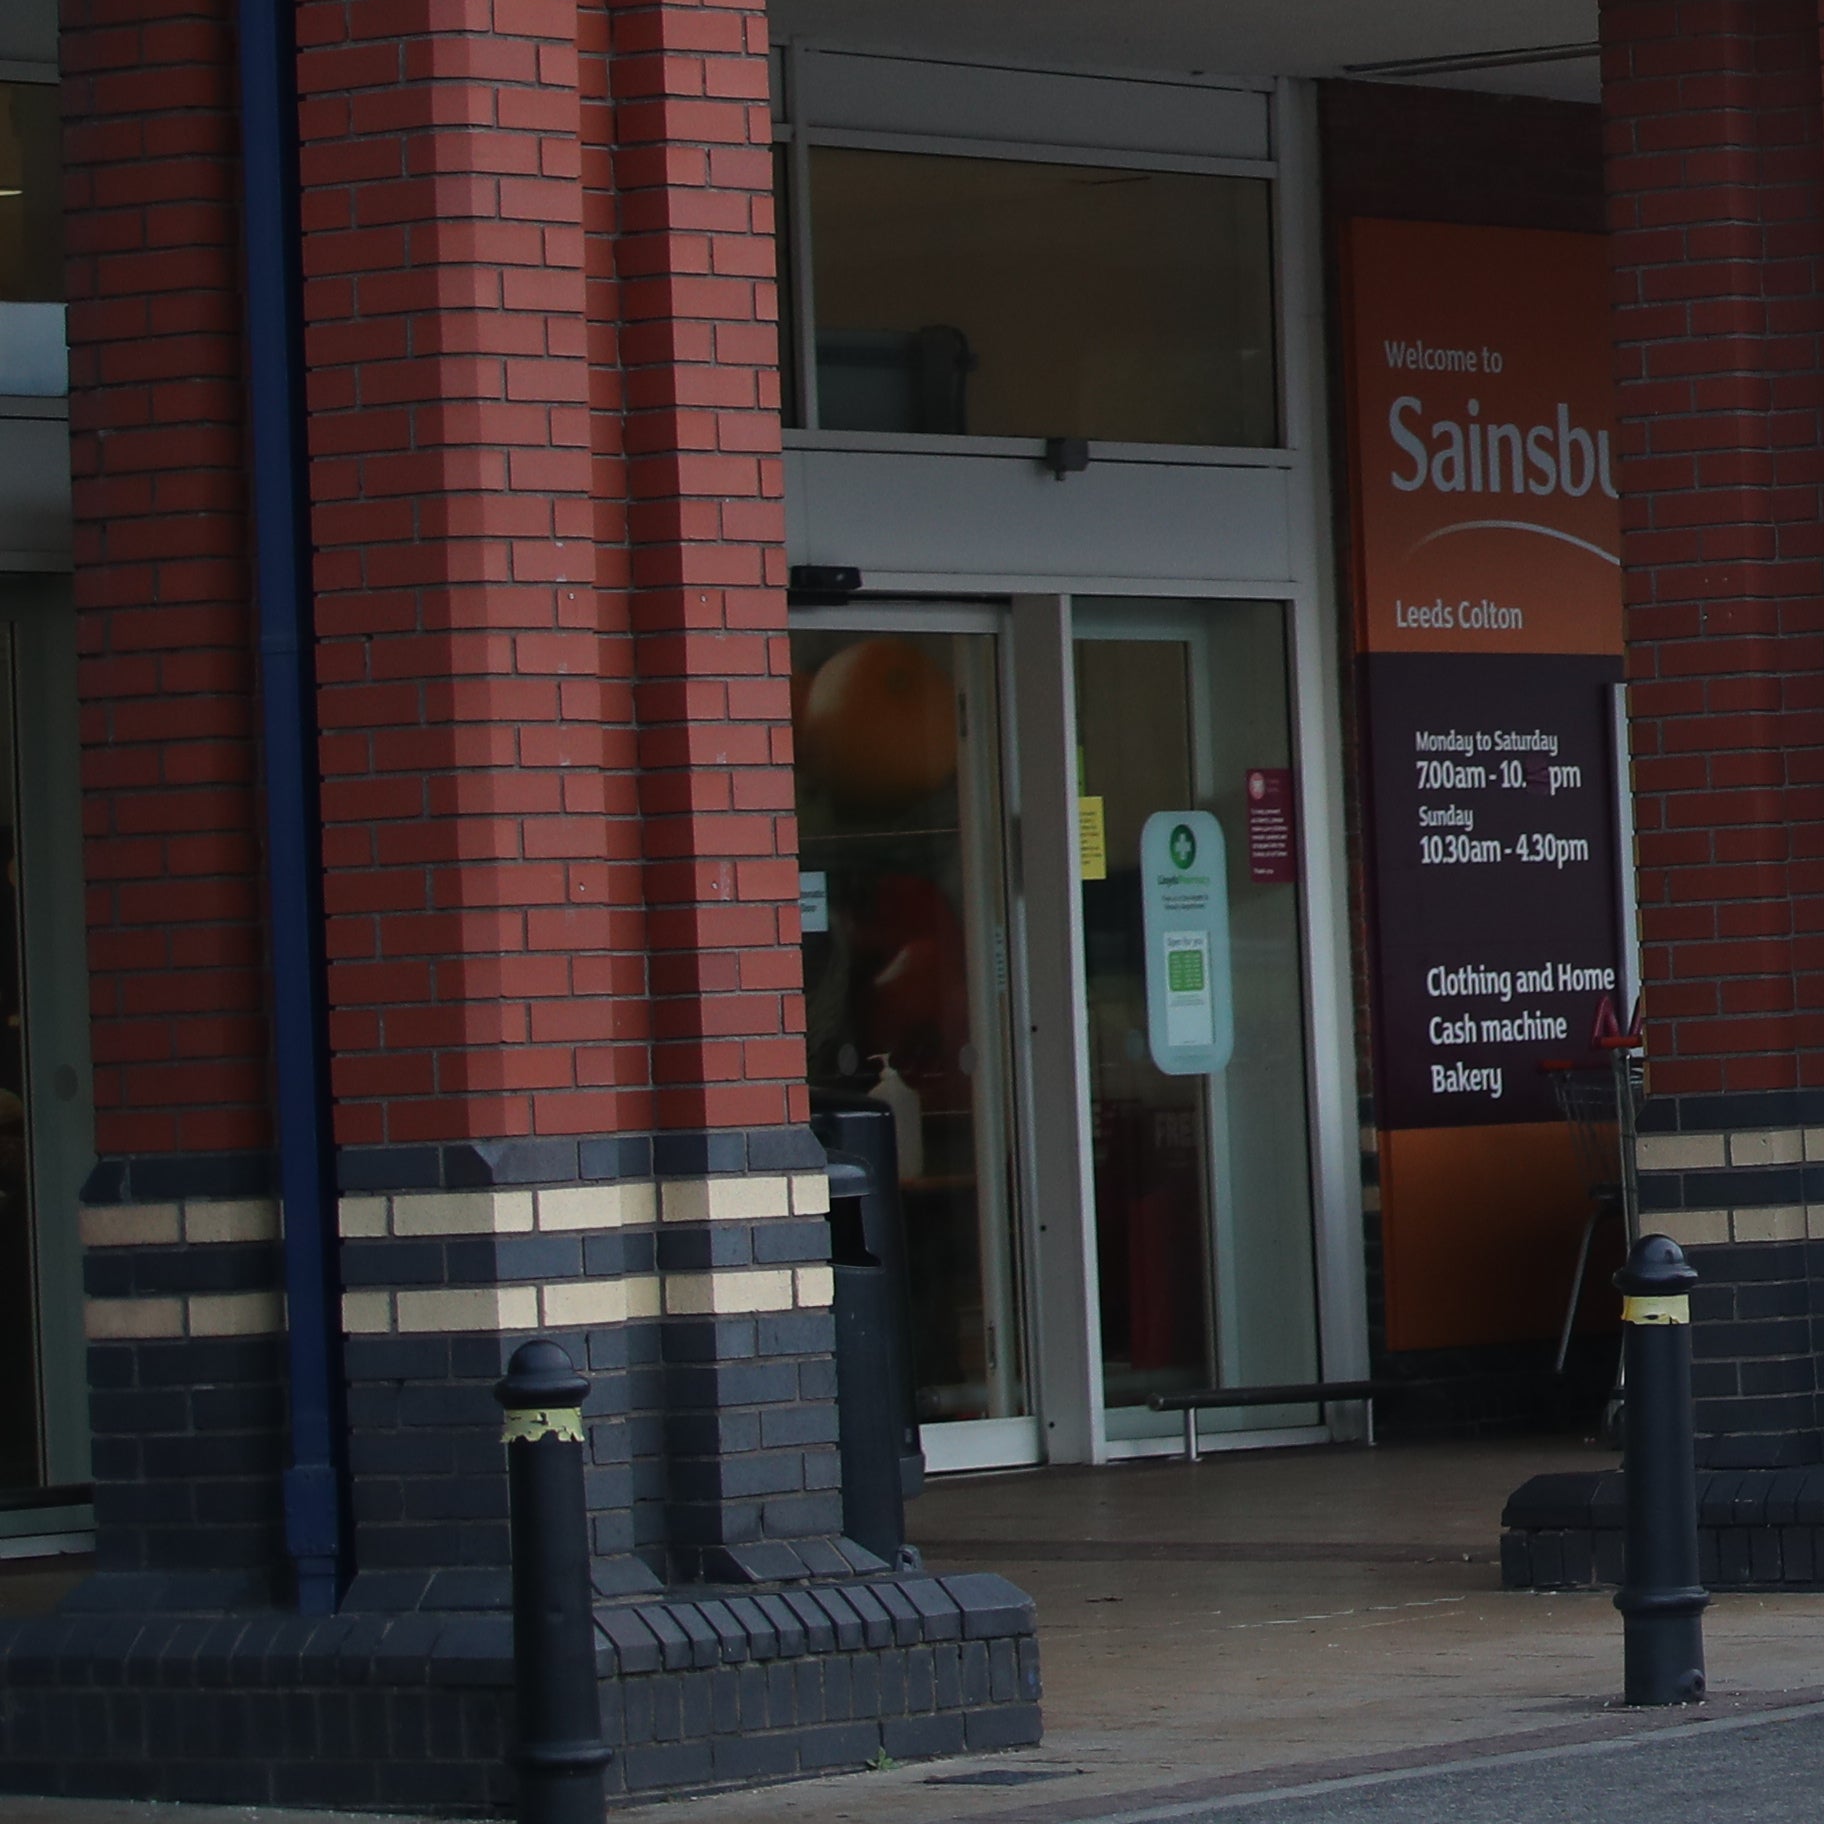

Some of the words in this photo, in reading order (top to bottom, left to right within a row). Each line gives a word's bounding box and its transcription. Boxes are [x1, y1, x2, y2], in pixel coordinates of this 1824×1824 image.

[1384, 340, 1476, 373] Welcome
[1481, 347, 1503, 374] to
[1396, 599, 1452, 629] Leeds
[1457, 599, 1523, 630] Colton
[1416, 730, 1474, 756] Monday
[1476, 731, 1492, 752] to
[1494, 730, 1558, 756] Saturday
[1416, 760, 1485, 789] 7.00am
[1418, 805, 1474, 832] Sunday
[1420, 835, 1501, 865] 10.30am
[1515, 833, 1589, 869] 4.30pm
[1427, 967, 1512, 1002] Clothing
[1516, 963, 1553, 994] and
[1558, 962, 1616, 992] Home
[1428, 1015, 1477, 1046] Cash
[1480, 1009, 1567, 1043] machine
[1432, 1060, 1503, 1097] Bakery
